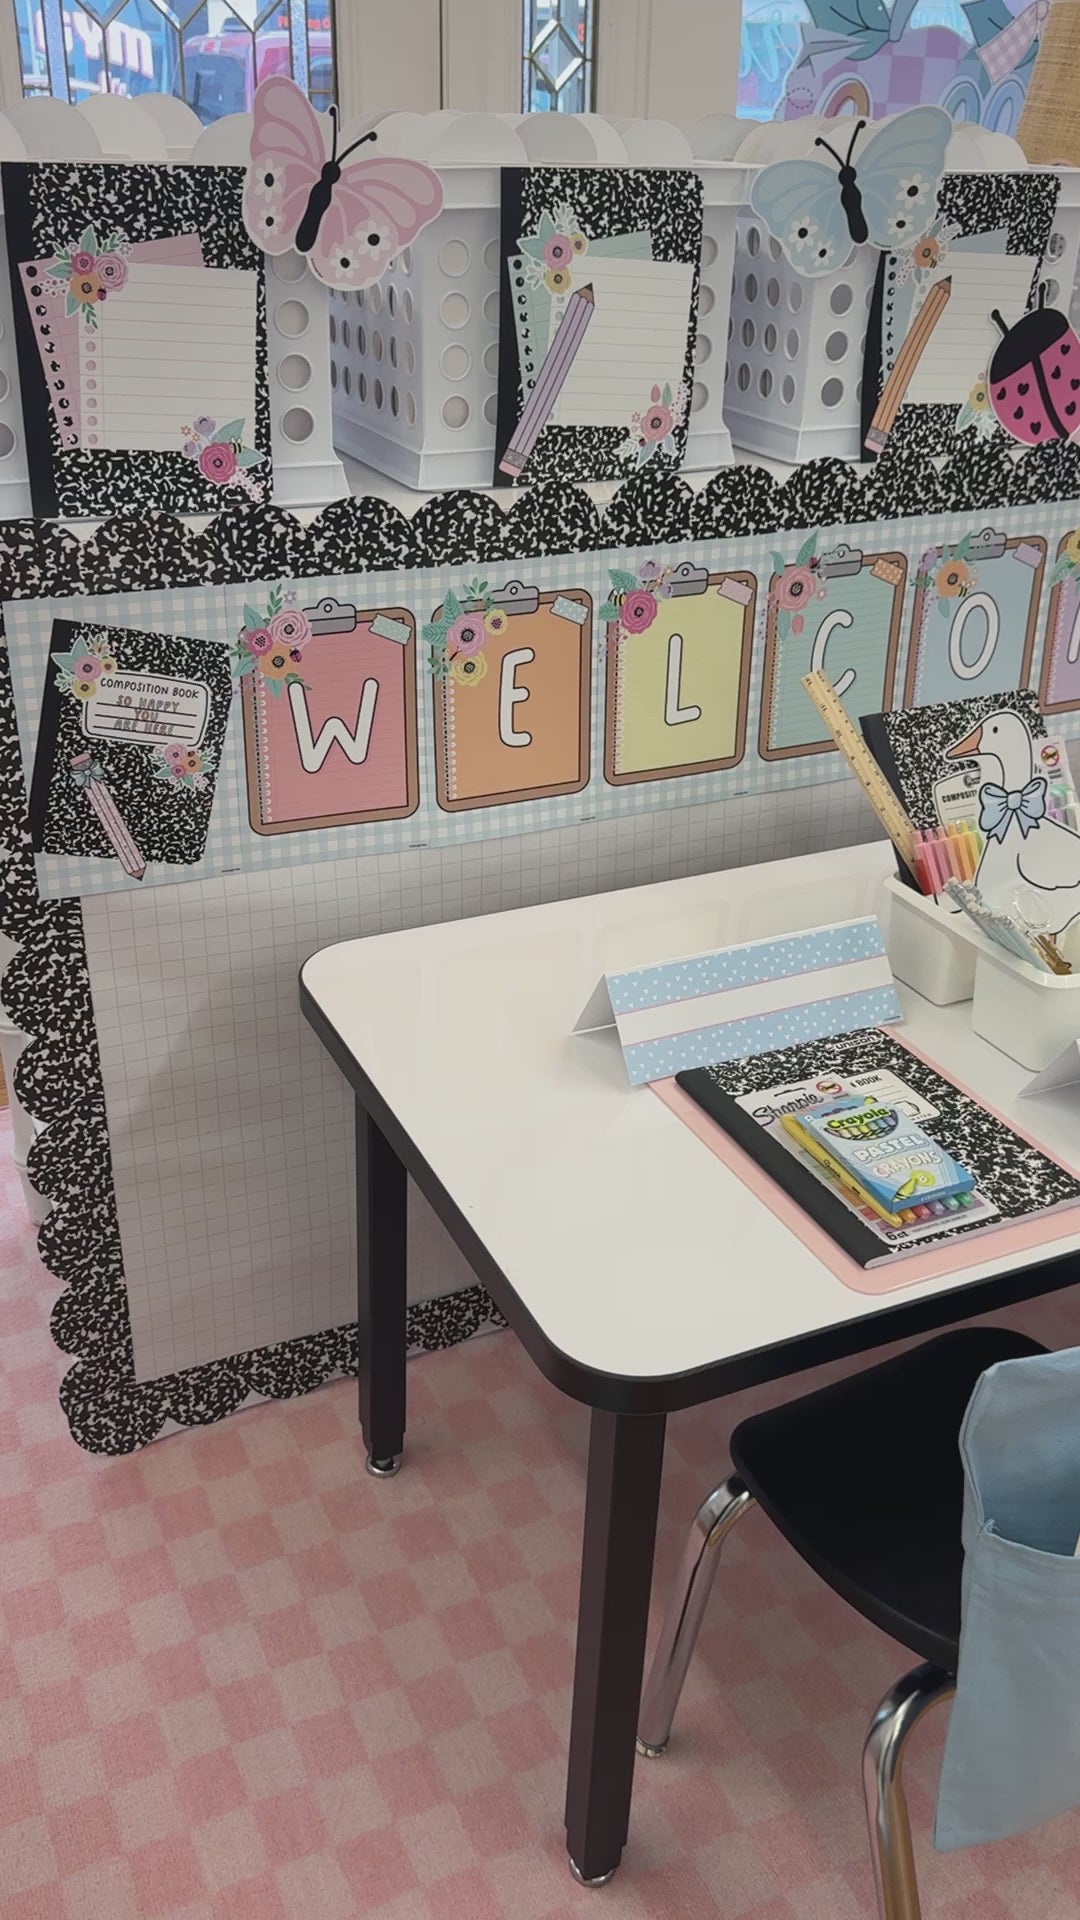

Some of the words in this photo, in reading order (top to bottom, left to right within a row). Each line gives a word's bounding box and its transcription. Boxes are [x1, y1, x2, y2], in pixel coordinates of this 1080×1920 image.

[100, 677, 169, 695] COMPOSITION
[172, 687, 200, 699] BOOK
[287, 678, 380, 773] W
[499, 647, 535, 748] E
[664, 633, 702, 726] L
[948, 591, 1000, 680] O
[116, 694, 132, 707] SO
[138, 697, 180, 713] HAPPY
[134, 708, 159, 720] YOU
[113, 719, 139, 731] ARE
[143, 722, 175, 736] HERE
[941, 788, 978, 803] COMPOSIT
[835, 1035, 876, 1050] unison
[856, 1074, 883, 1087] BOOK
[752, 1092, 824, 1127] Sharpie
[827, 1108, 891, 1129] Crayola
[852, 1134, 926, 1162] PASTEL
[872, 1151, 943, 1178] CRAYONS
